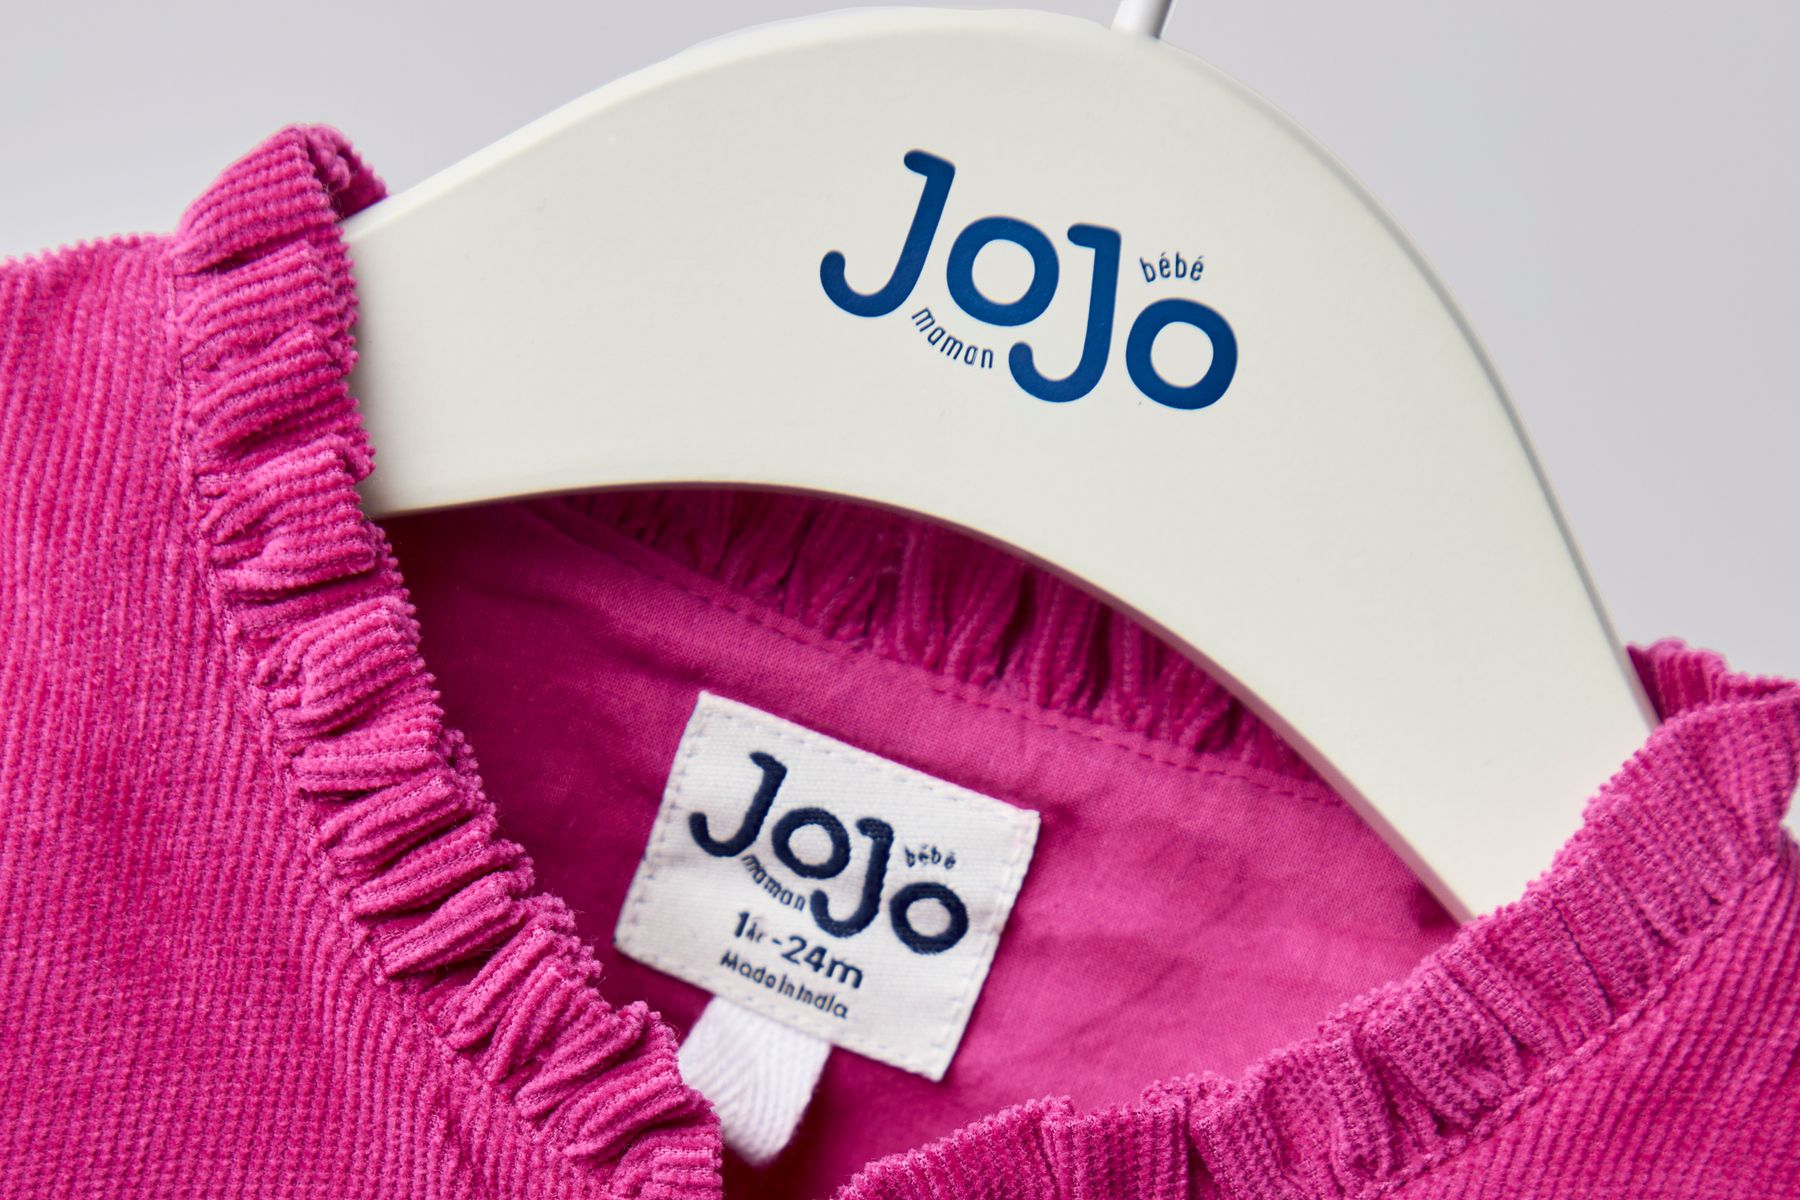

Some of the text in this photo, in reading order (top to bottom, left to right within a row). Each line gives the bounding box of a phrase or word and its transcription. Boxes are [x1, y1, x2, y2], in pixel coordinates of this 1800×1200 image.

[1139, 250, 1205, 282] bébé
[911, 307, 994, 369] maman
[742, 854, 805, 911] maman
[720, 950, 777, 989] Made
[796, 984, 849, 1019] India
